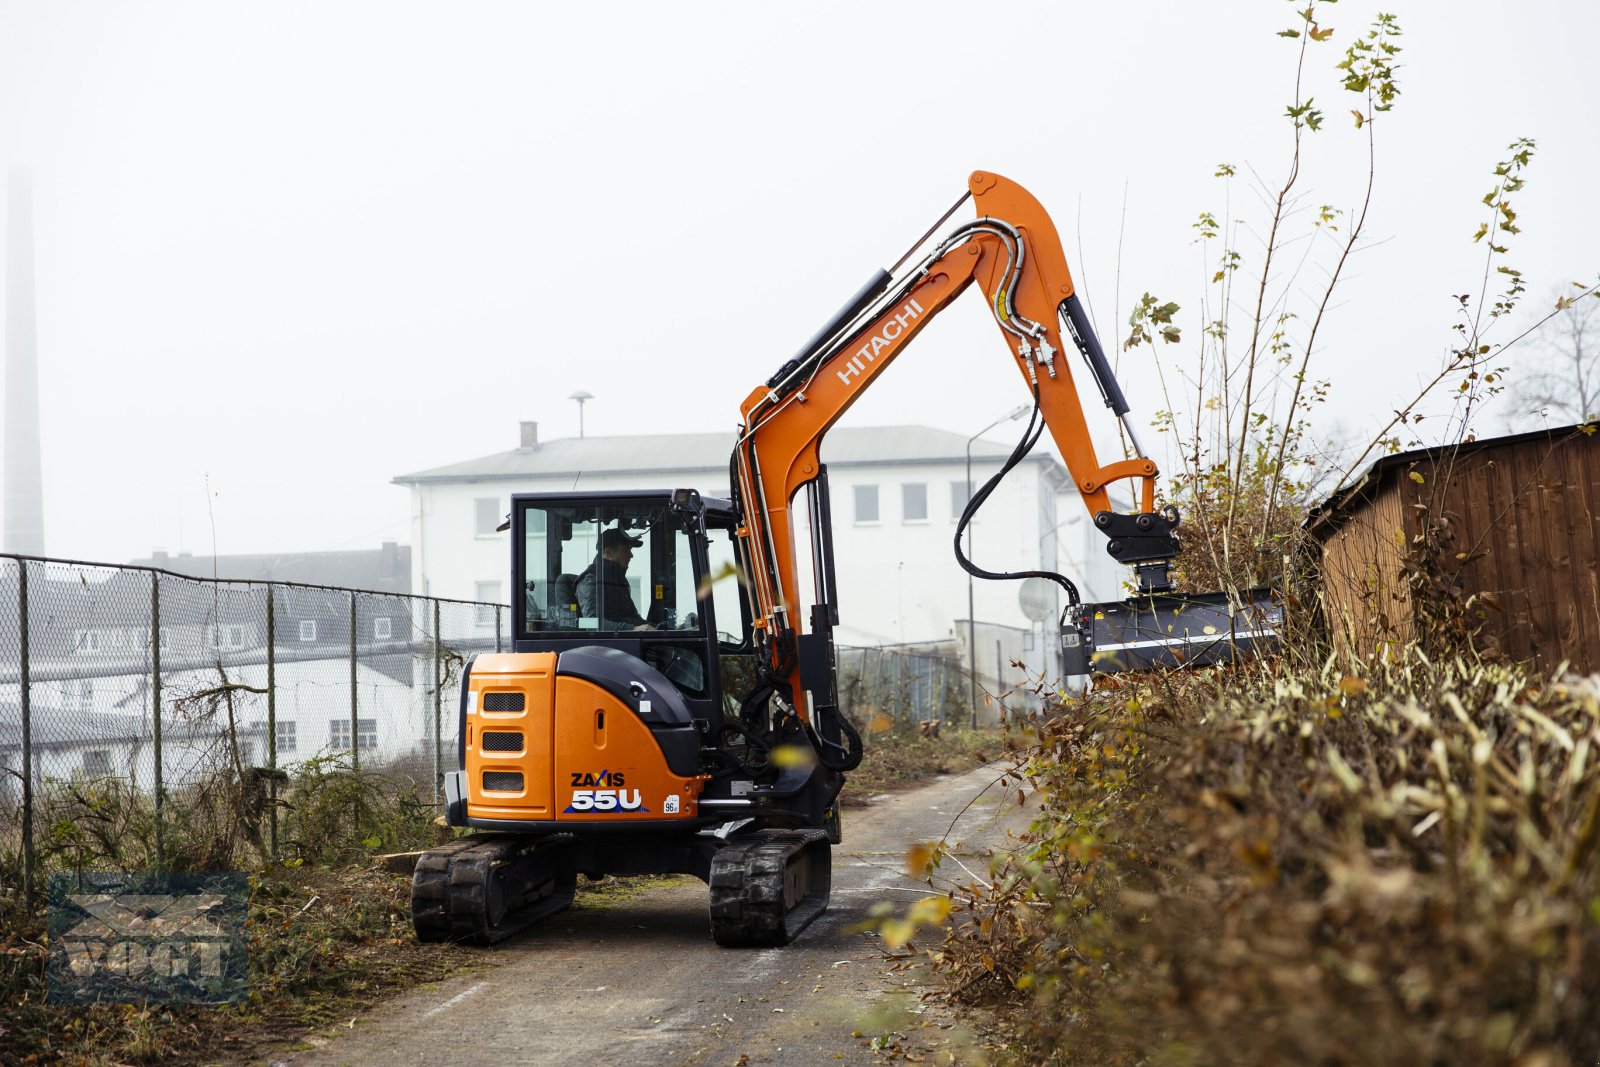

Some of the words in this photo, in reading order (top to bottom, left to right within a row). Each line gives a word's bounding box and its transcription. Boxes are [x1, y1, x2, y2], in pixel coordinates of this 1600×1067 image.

[836, 299, 924, 386] HITACHI
[571, 770, 625, 788] ZAXIS
[571, 788, 642, 811] 55U
[665, 802, 674, 812] 96
